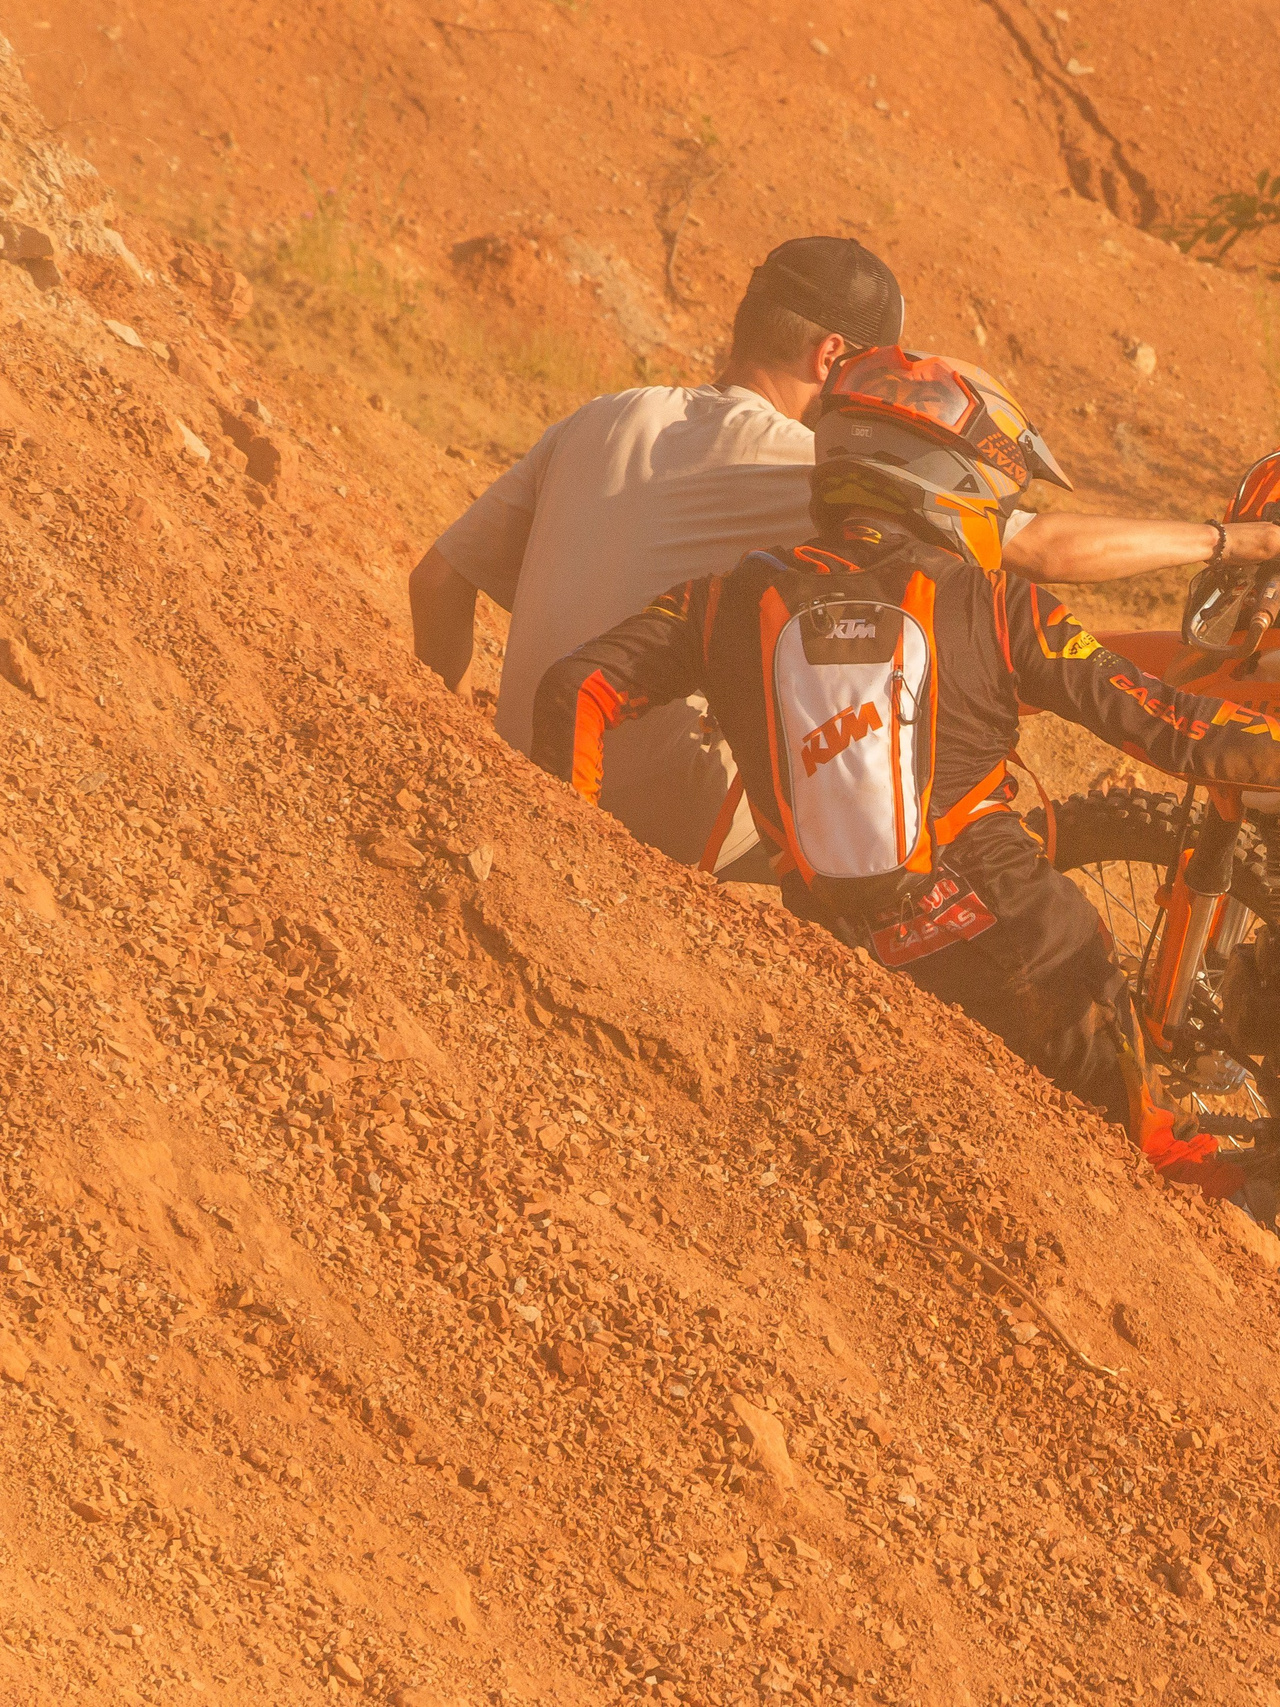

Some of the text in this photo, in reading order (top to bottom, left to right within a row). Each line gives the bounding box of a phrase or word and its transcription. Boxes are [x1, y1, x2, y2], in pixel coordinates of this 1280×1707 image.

[826, 619, 876, 639] KTM
[800, 701, 883, 778] KTM
[889, 908, 977, 953] GASAS
